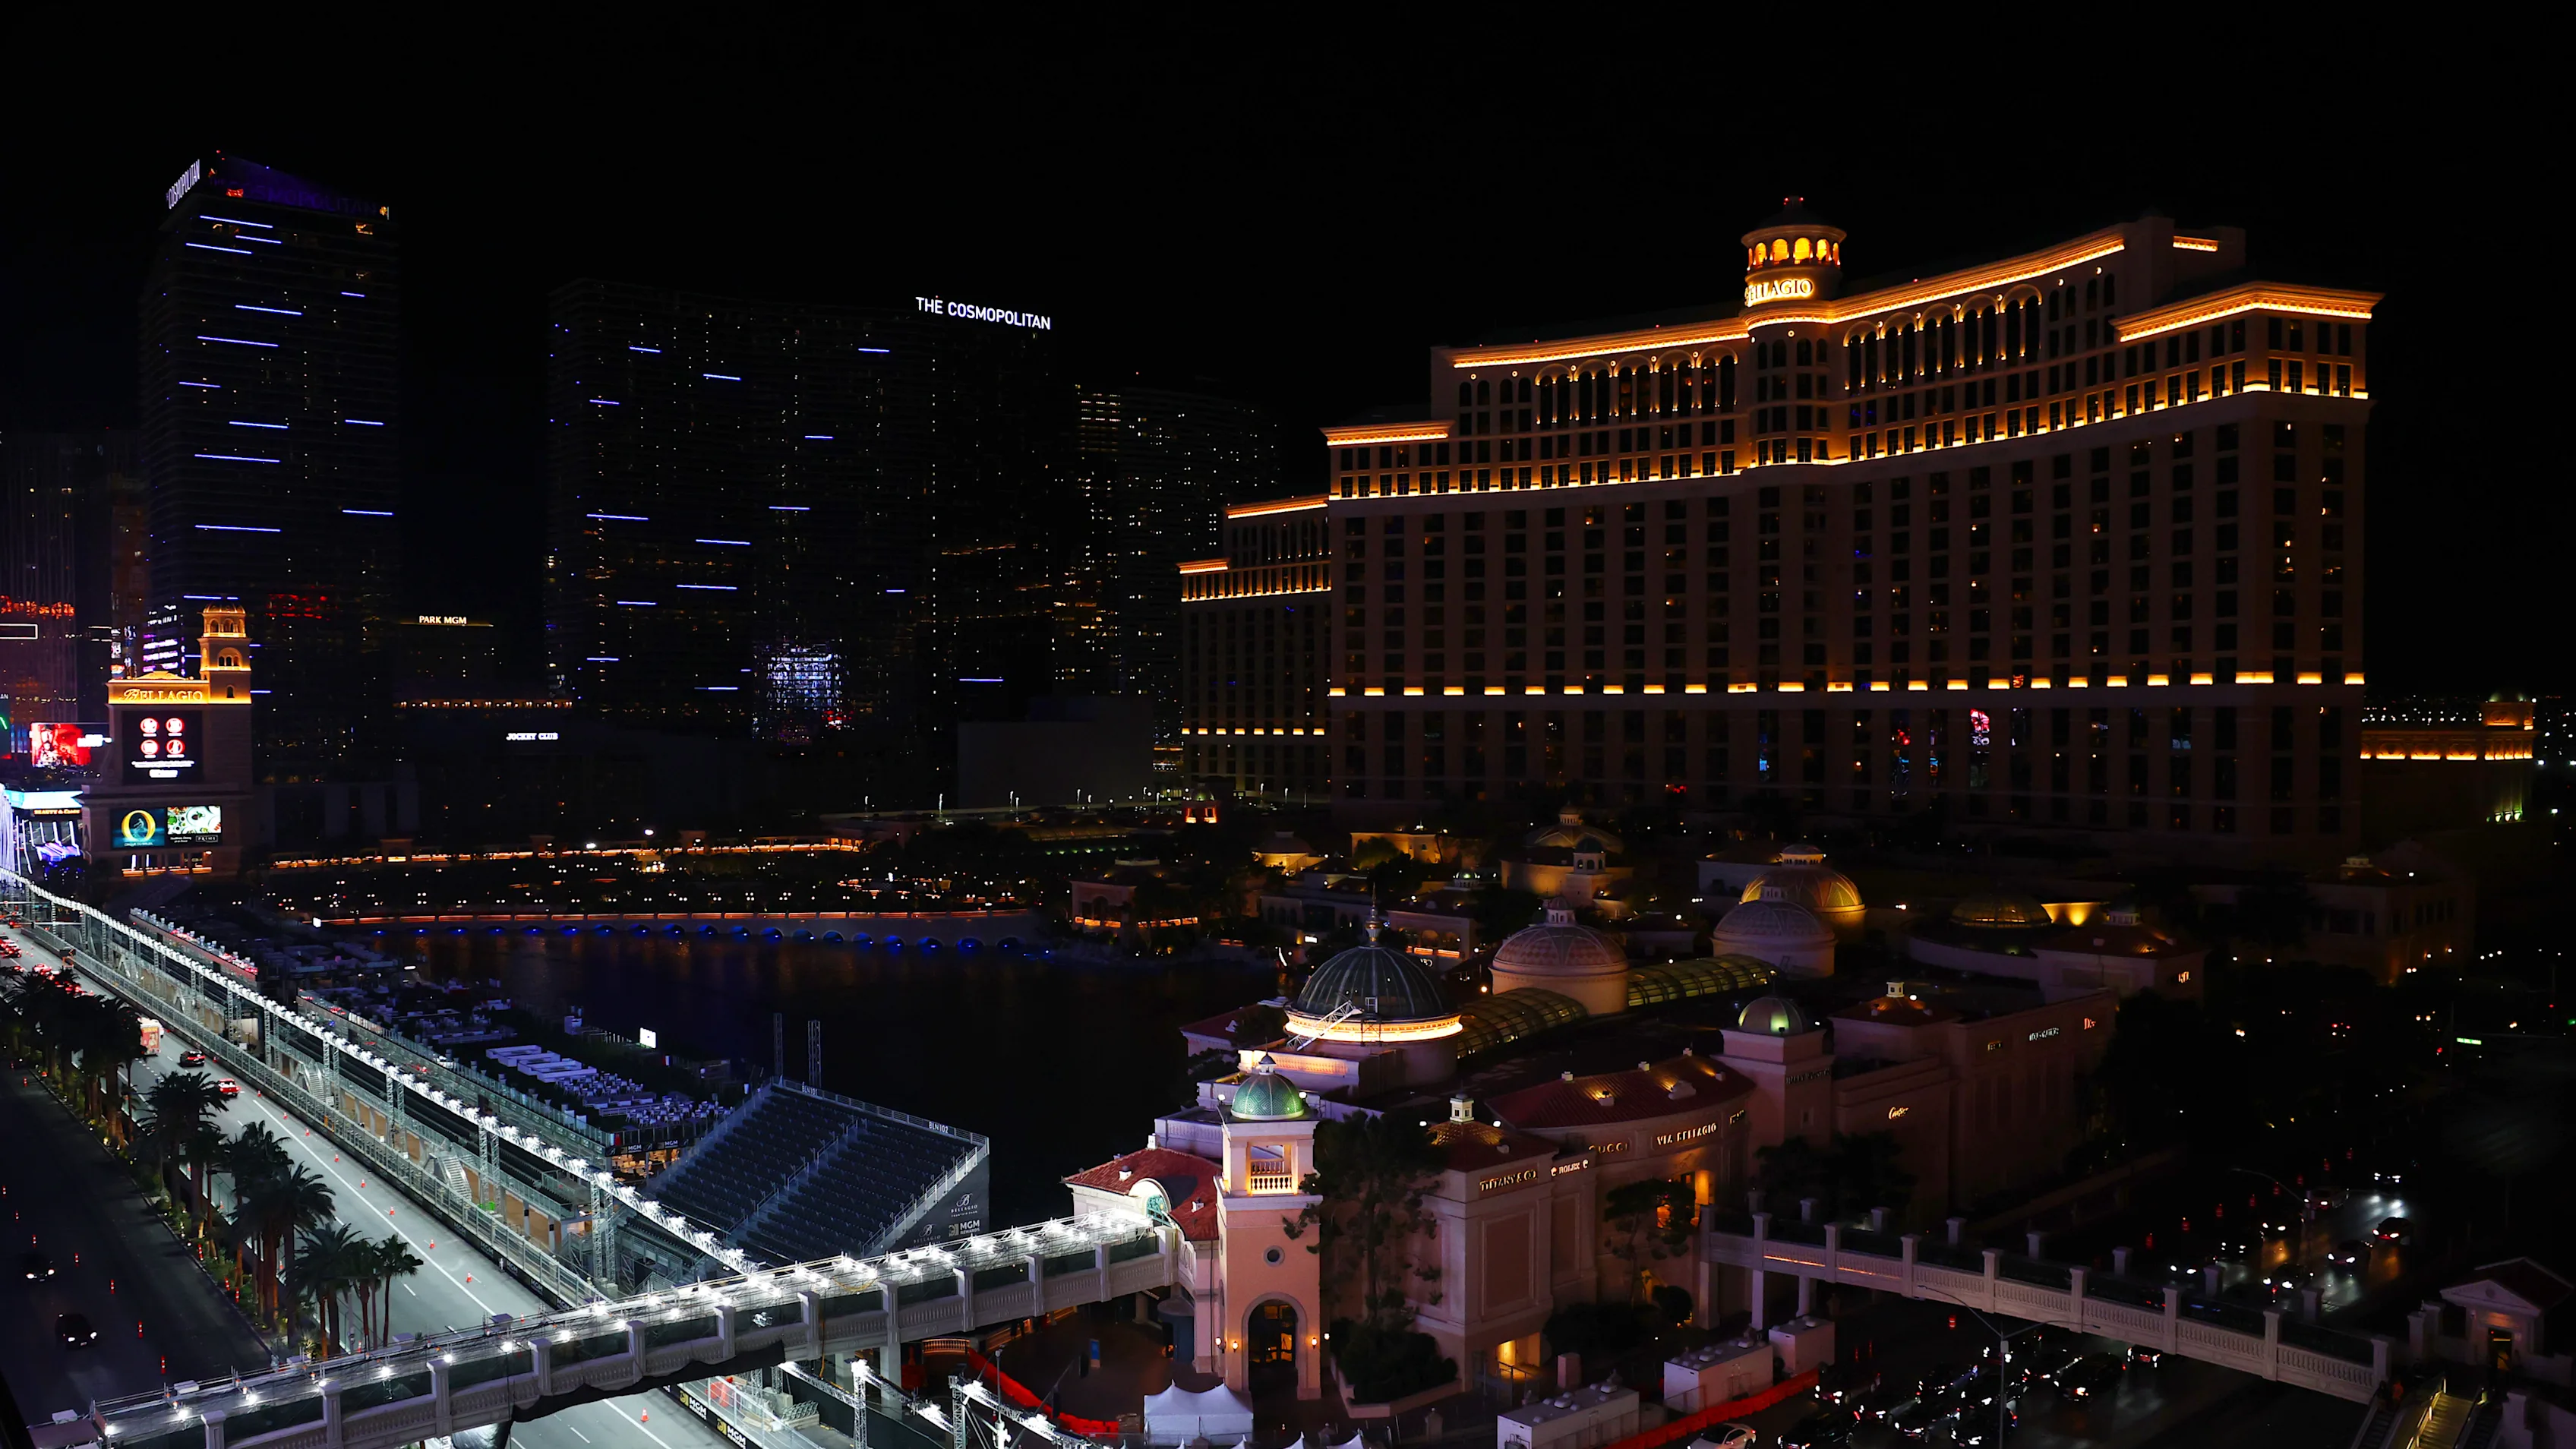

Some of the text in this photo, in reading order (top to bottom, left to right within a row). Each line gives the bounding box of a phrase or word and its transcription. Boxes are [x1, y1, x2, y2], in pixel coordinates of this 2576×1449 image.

[915, 297, 1051, 330] THE COSMOPOLITAN
[419, 615, 467, 624] PARK MGM
[119, 688, 203, 701] BELLAGIO
[538, 732, 559, 740] CLUB
[1656, 1134, 1673, 1146] VIA
[1559, 1162, 1580, 1175] ROLEX
[950, 1204, 978, 1213] BELLAGIO
[960, 1220, 980, 1230] MGM
[690, 1397, 706, 1415] MGM
[728, 1425, 746, 1445] MGM
